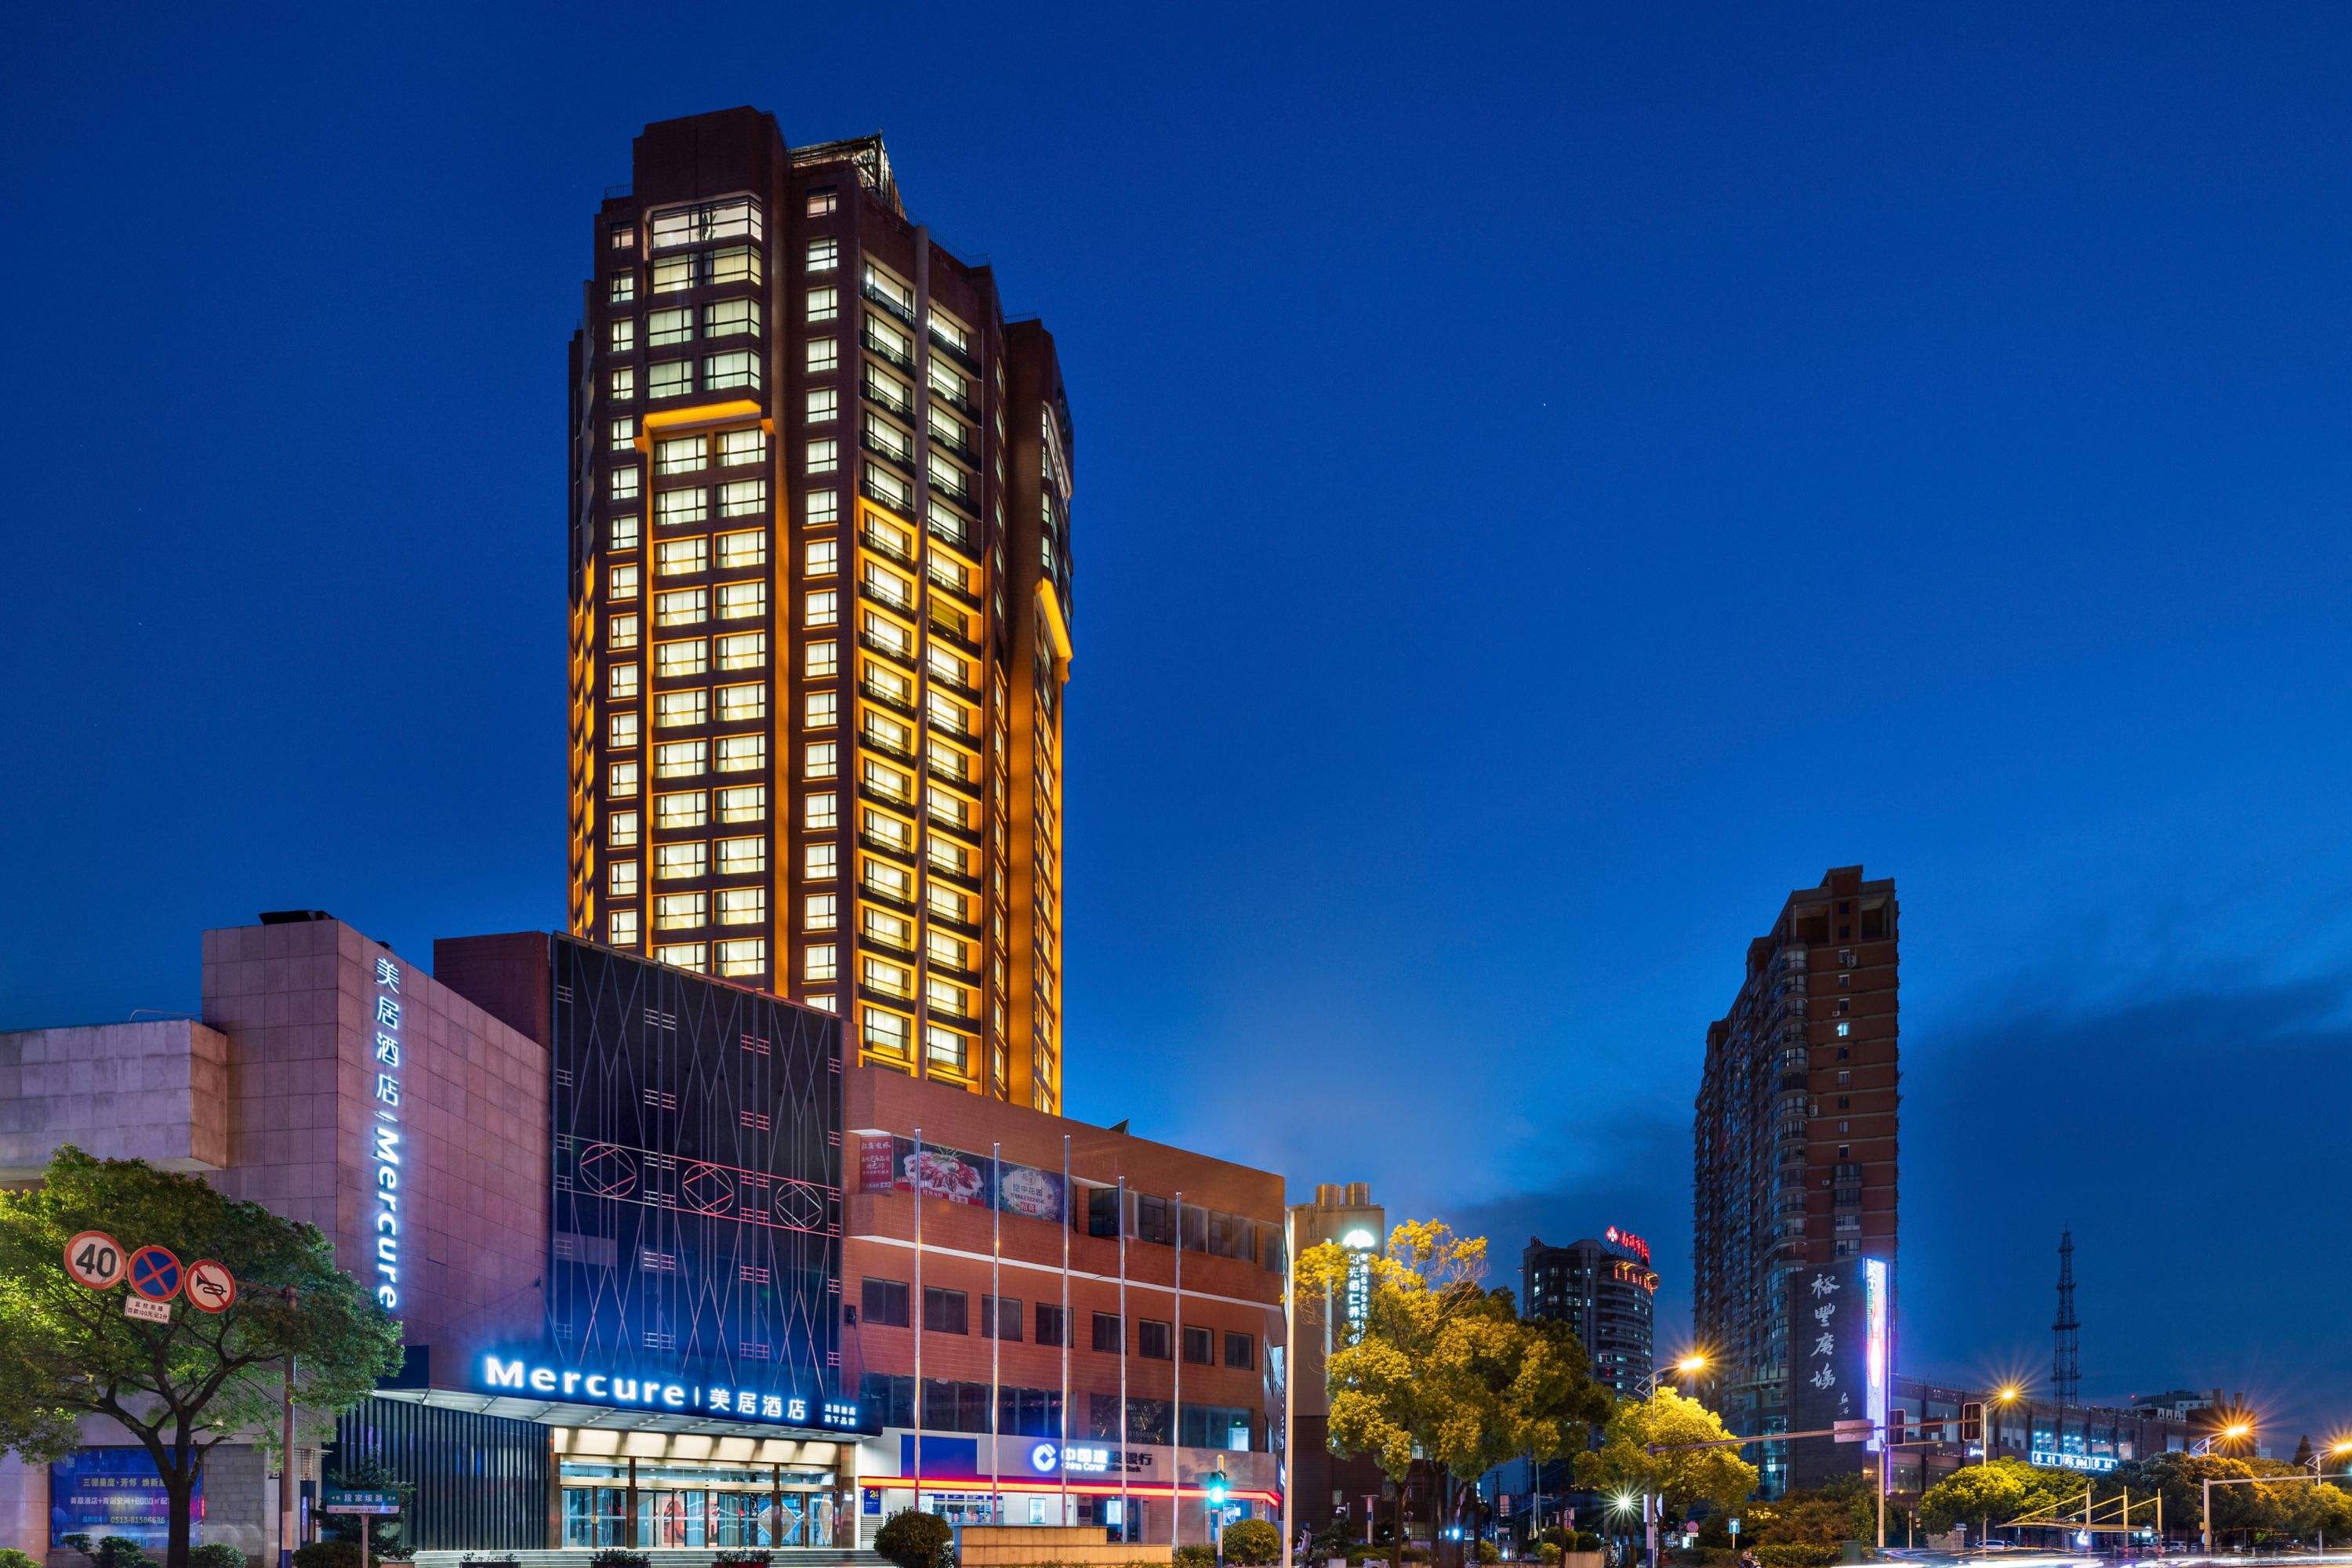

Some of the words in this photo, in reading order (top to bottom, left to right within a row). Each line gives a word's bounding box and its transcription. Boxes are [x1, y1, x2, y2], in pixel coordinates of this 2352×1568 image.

[376, 958, 400, 1106] 美居酒店
[378, 1127, 400, 1308] Mercure
[75, 1243, 117, 1278] 40
[486, 1357, 685, 1406] Mercure
[709, 1388, 806, 1421] 美居酒店
[344, 1494, 383, 1502] 段家坝路
[869, 1490, 879, 1498] 24
